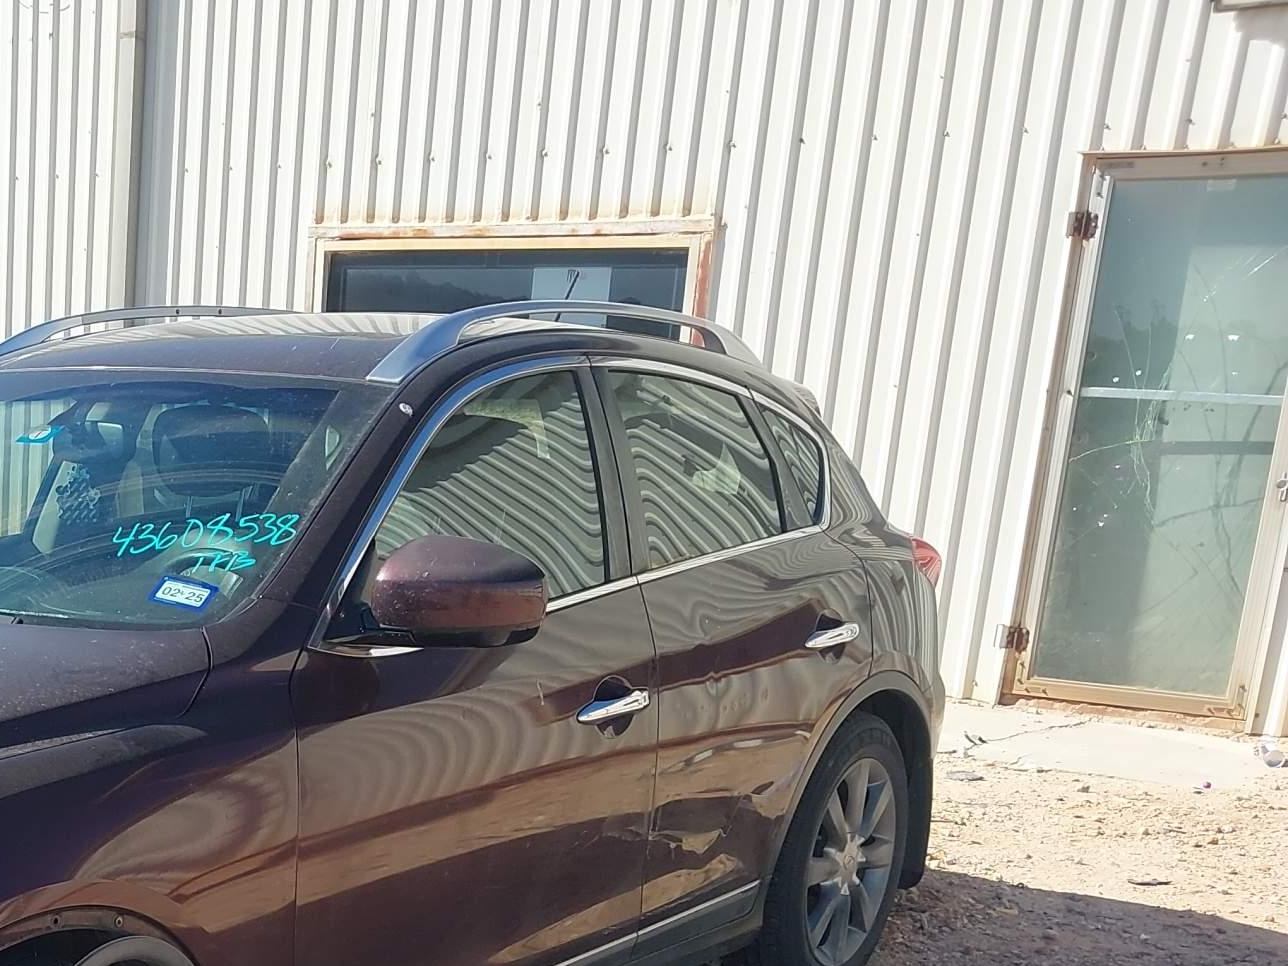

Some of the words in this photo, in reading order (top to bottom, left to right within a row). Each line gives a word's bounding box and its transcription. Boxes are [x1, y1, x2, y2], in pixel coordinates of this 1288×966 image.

[112, 513, 300, 557] 43608538
[161, 586, 181, 598] 02
[184, 591, 205, 603] 25
